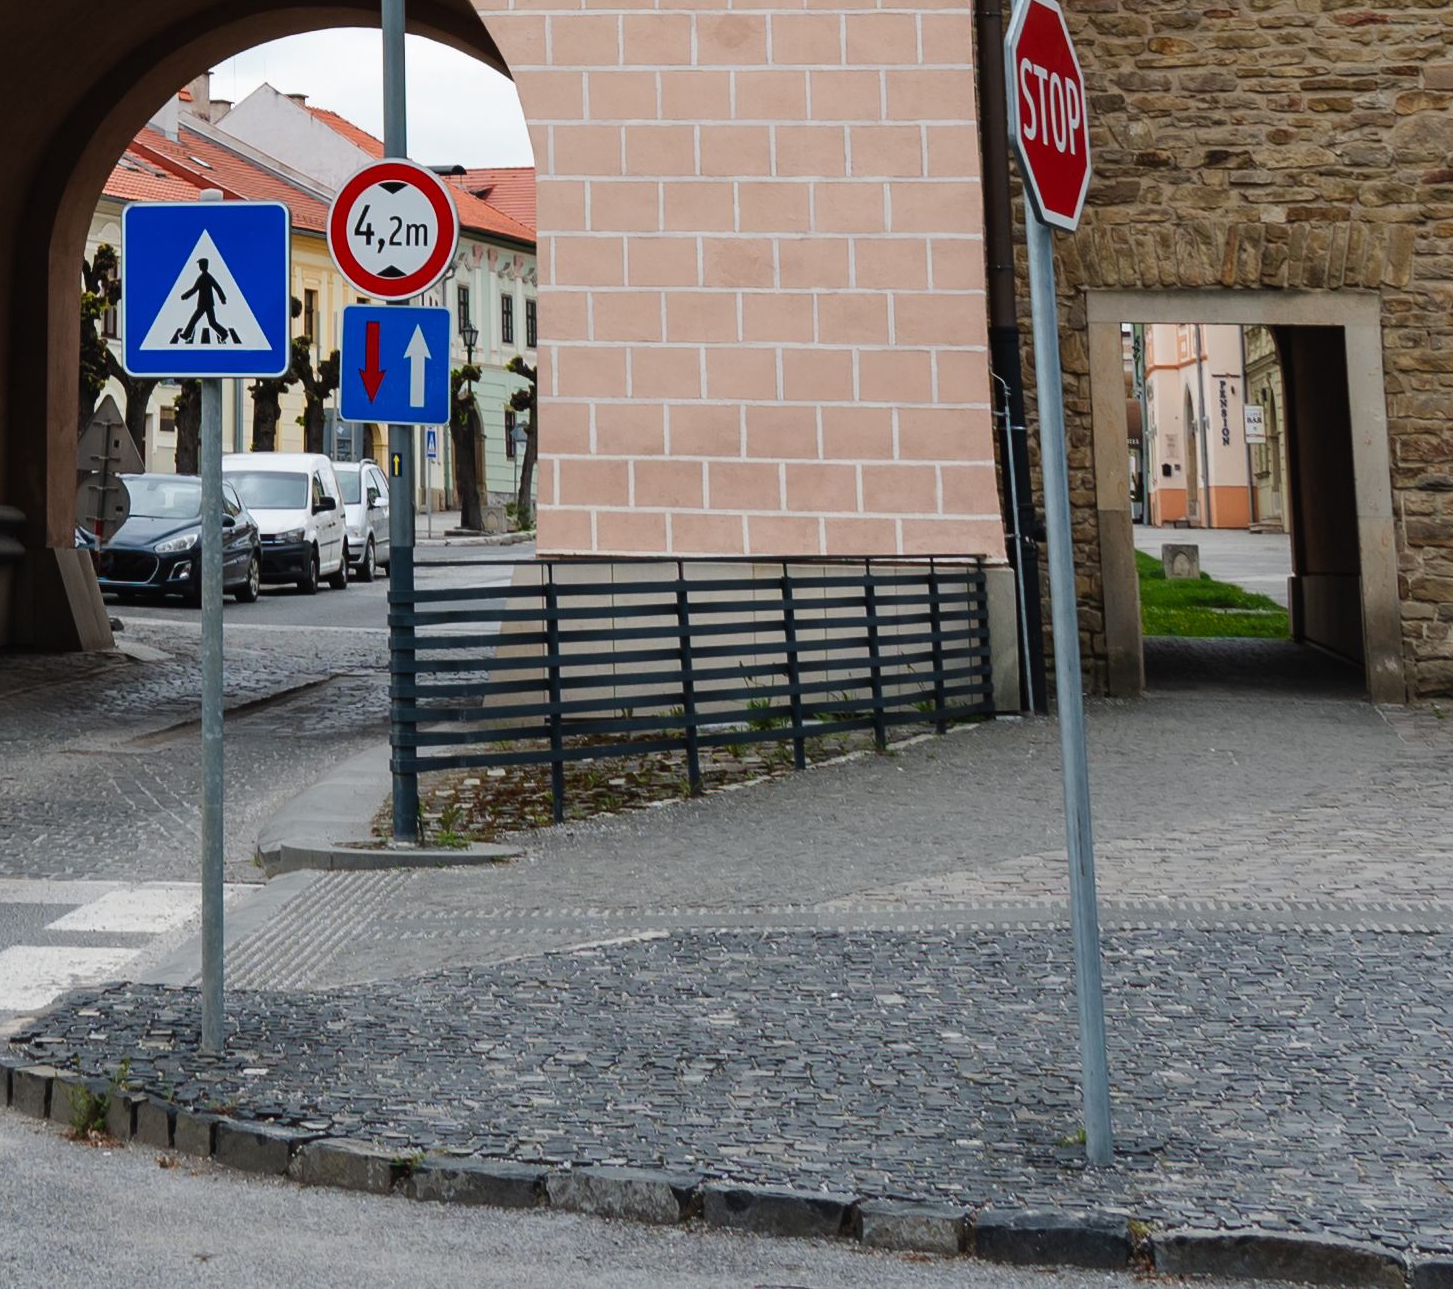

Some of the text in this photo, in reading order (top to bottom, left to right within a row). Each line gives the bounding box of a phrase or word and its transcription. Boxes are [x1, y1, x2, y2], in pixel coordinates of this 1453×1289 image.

[1020, 57, 1081, 155] STOP
[354, 204, 428, 254] 4,2m
[1219, 380, 1230, 446] PENSION
